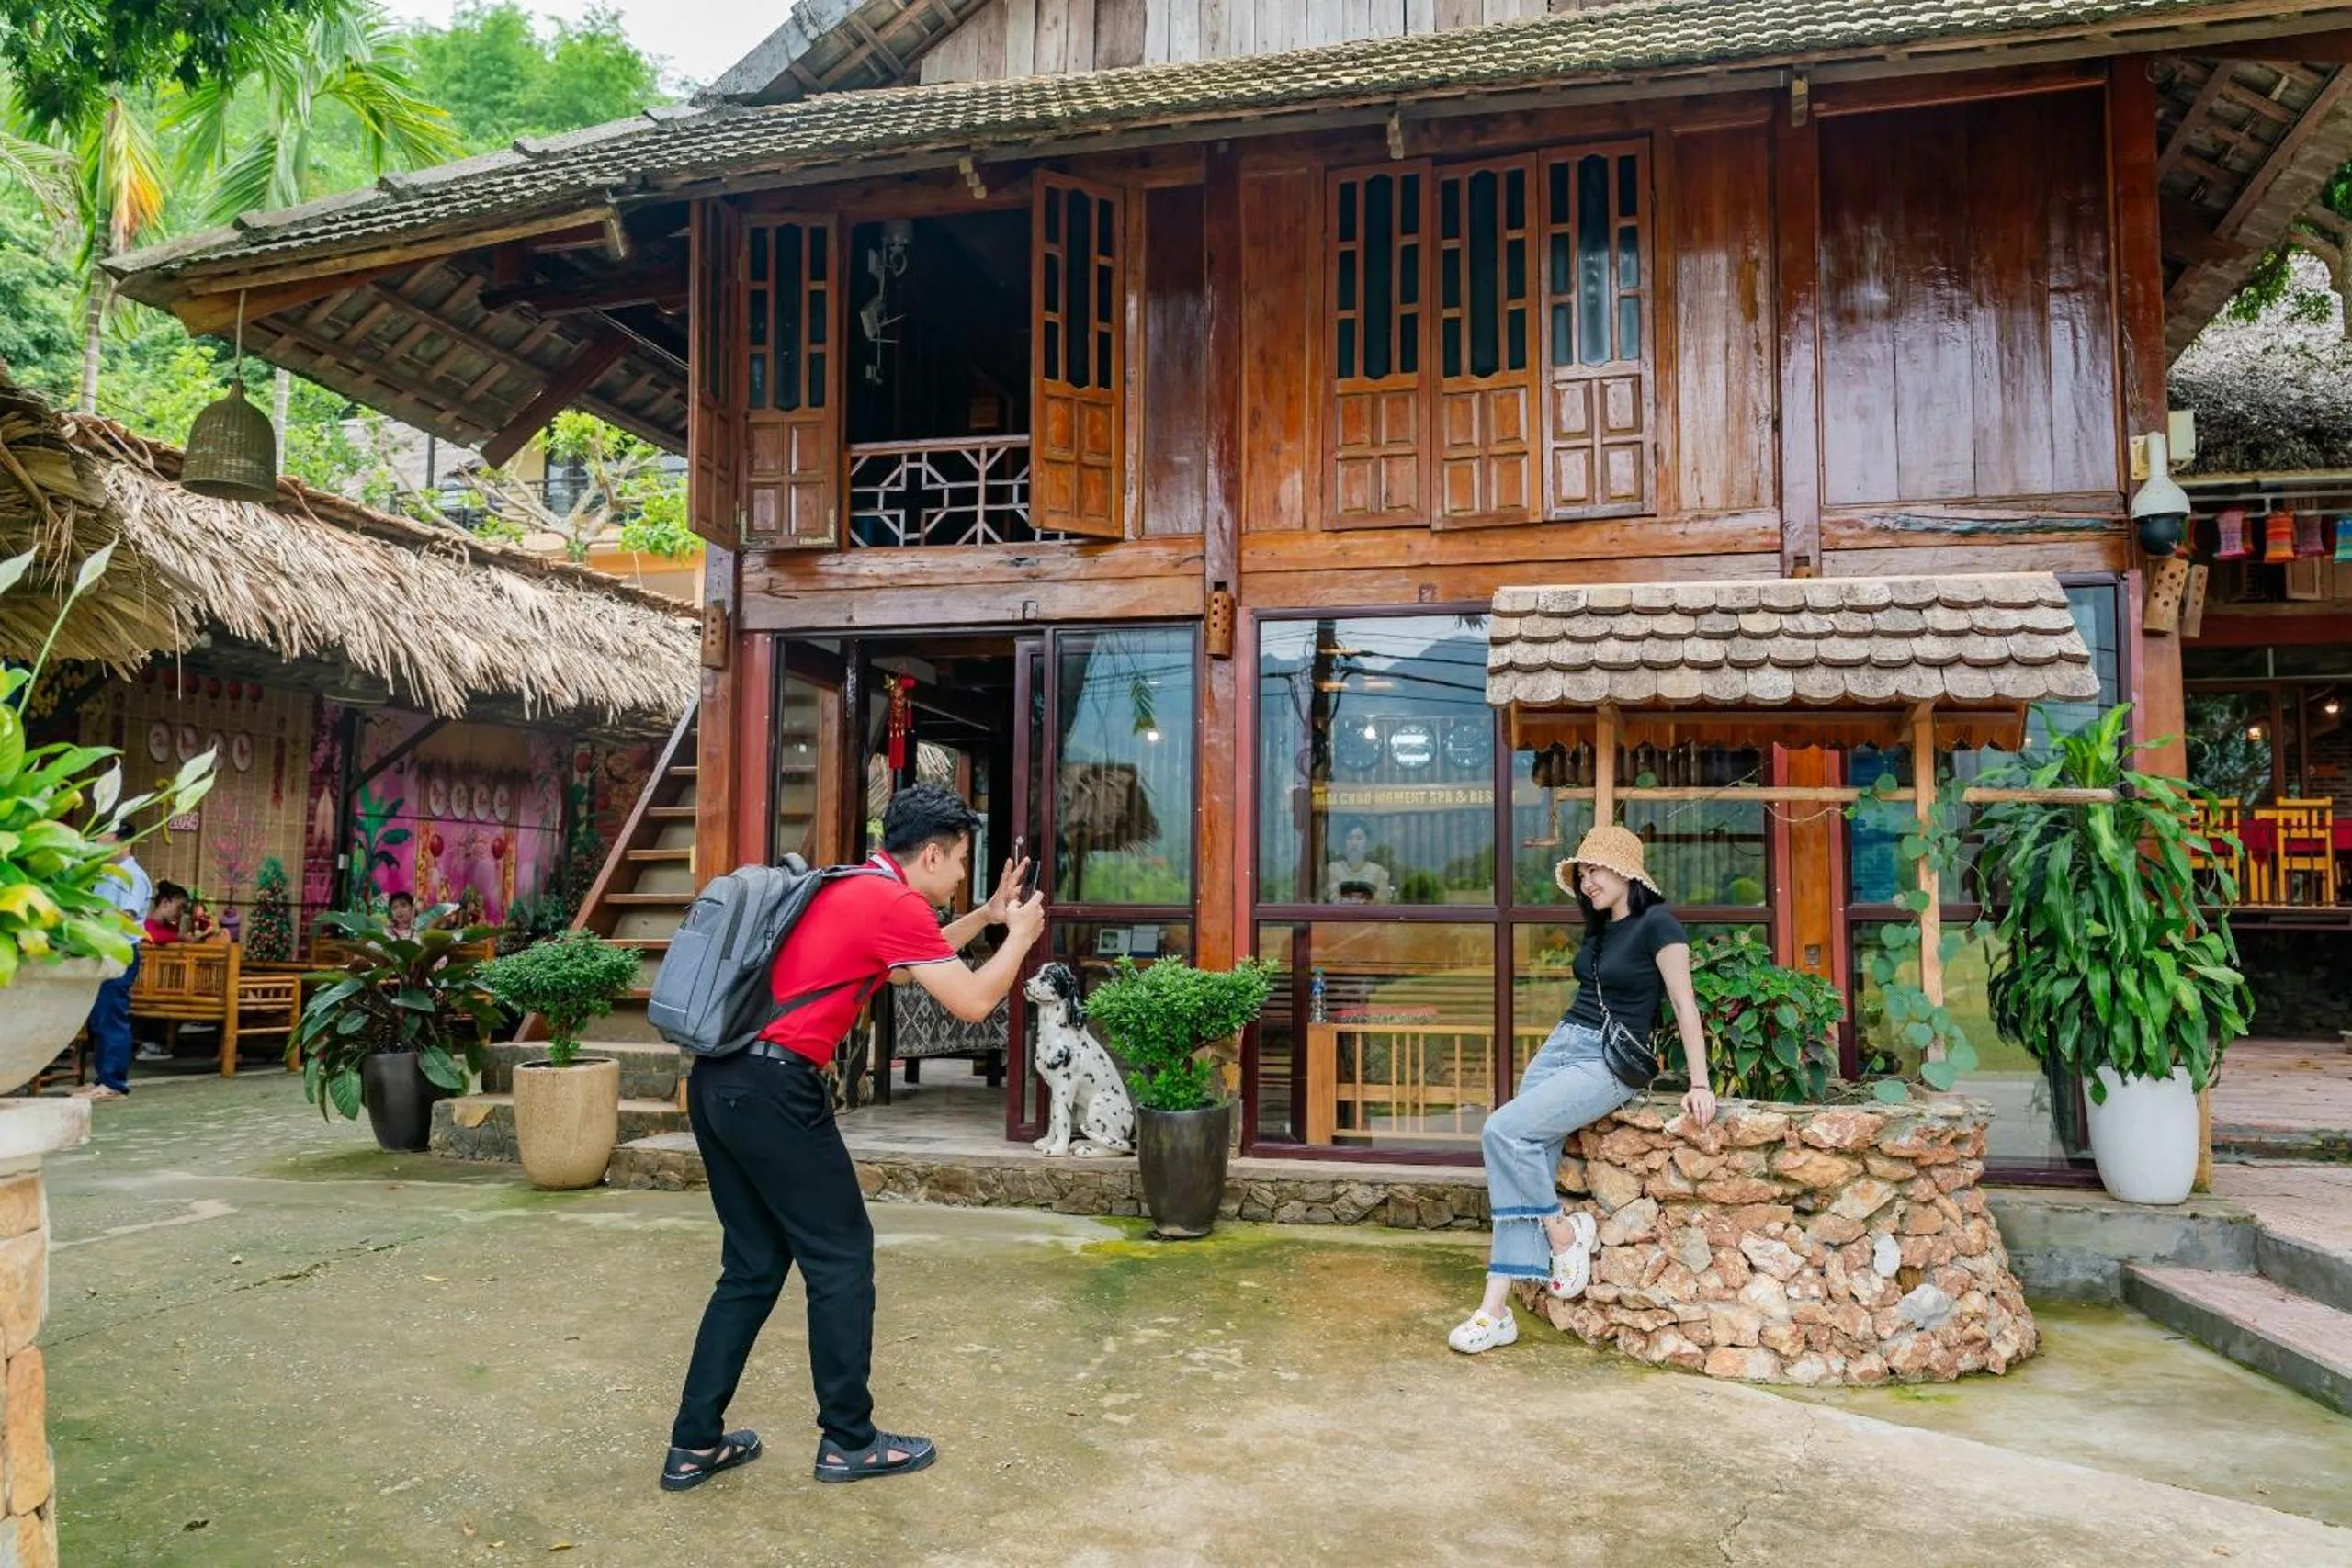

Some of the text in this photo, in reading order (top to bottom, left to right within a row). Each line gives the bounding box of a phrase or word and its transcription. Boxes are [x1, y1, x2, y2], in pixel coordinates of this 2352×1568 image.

[1375, 790, 1427, 805] MOMENT
[1430, 789, 1453, 804] SPA
[1455, 789, 1468, 804] &
